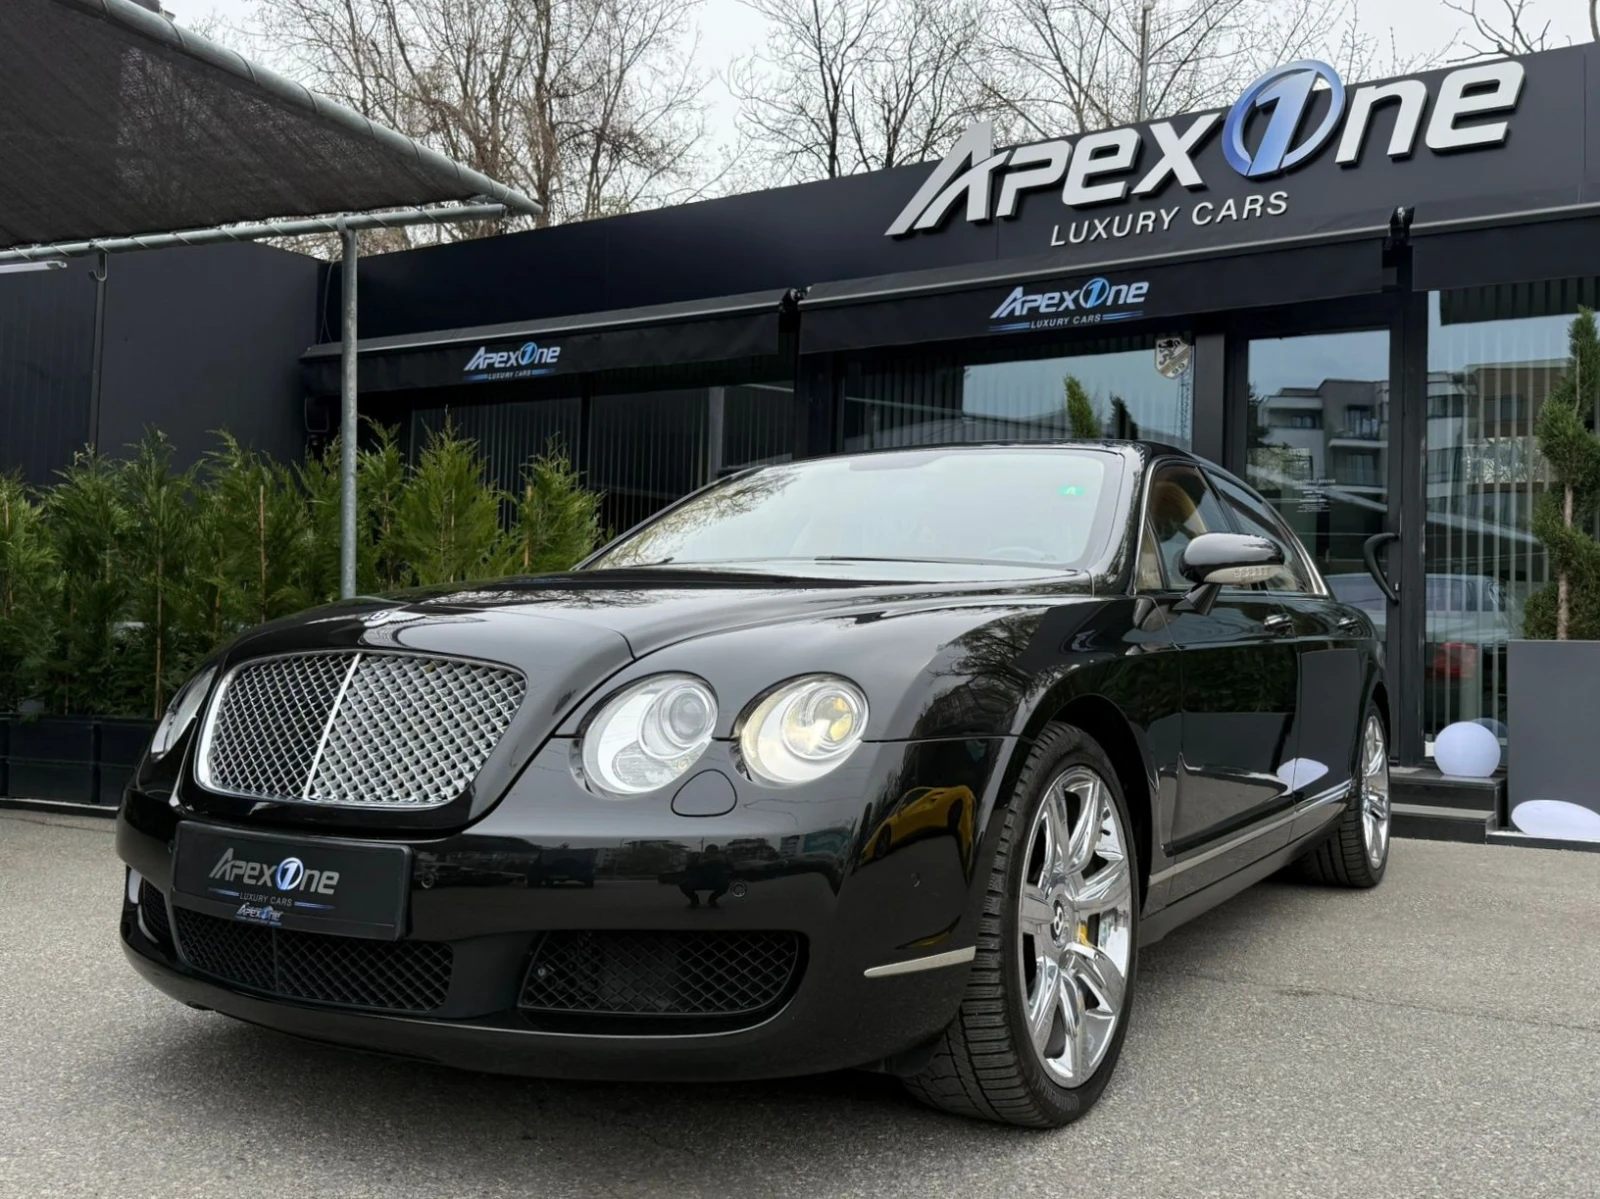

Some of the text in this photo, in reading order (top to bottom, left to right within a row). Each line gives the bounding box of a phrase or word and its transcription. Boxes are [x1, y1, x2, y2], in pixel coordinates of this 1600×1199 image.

[1050, 191, 1289, 247] LUXURY CARS
[1030, 314, 1101, 329] LUXURY CARS
[488, 369, 532, 380] LUXURY CARS
[239, 892, 293, 907] LUXURY CARS
